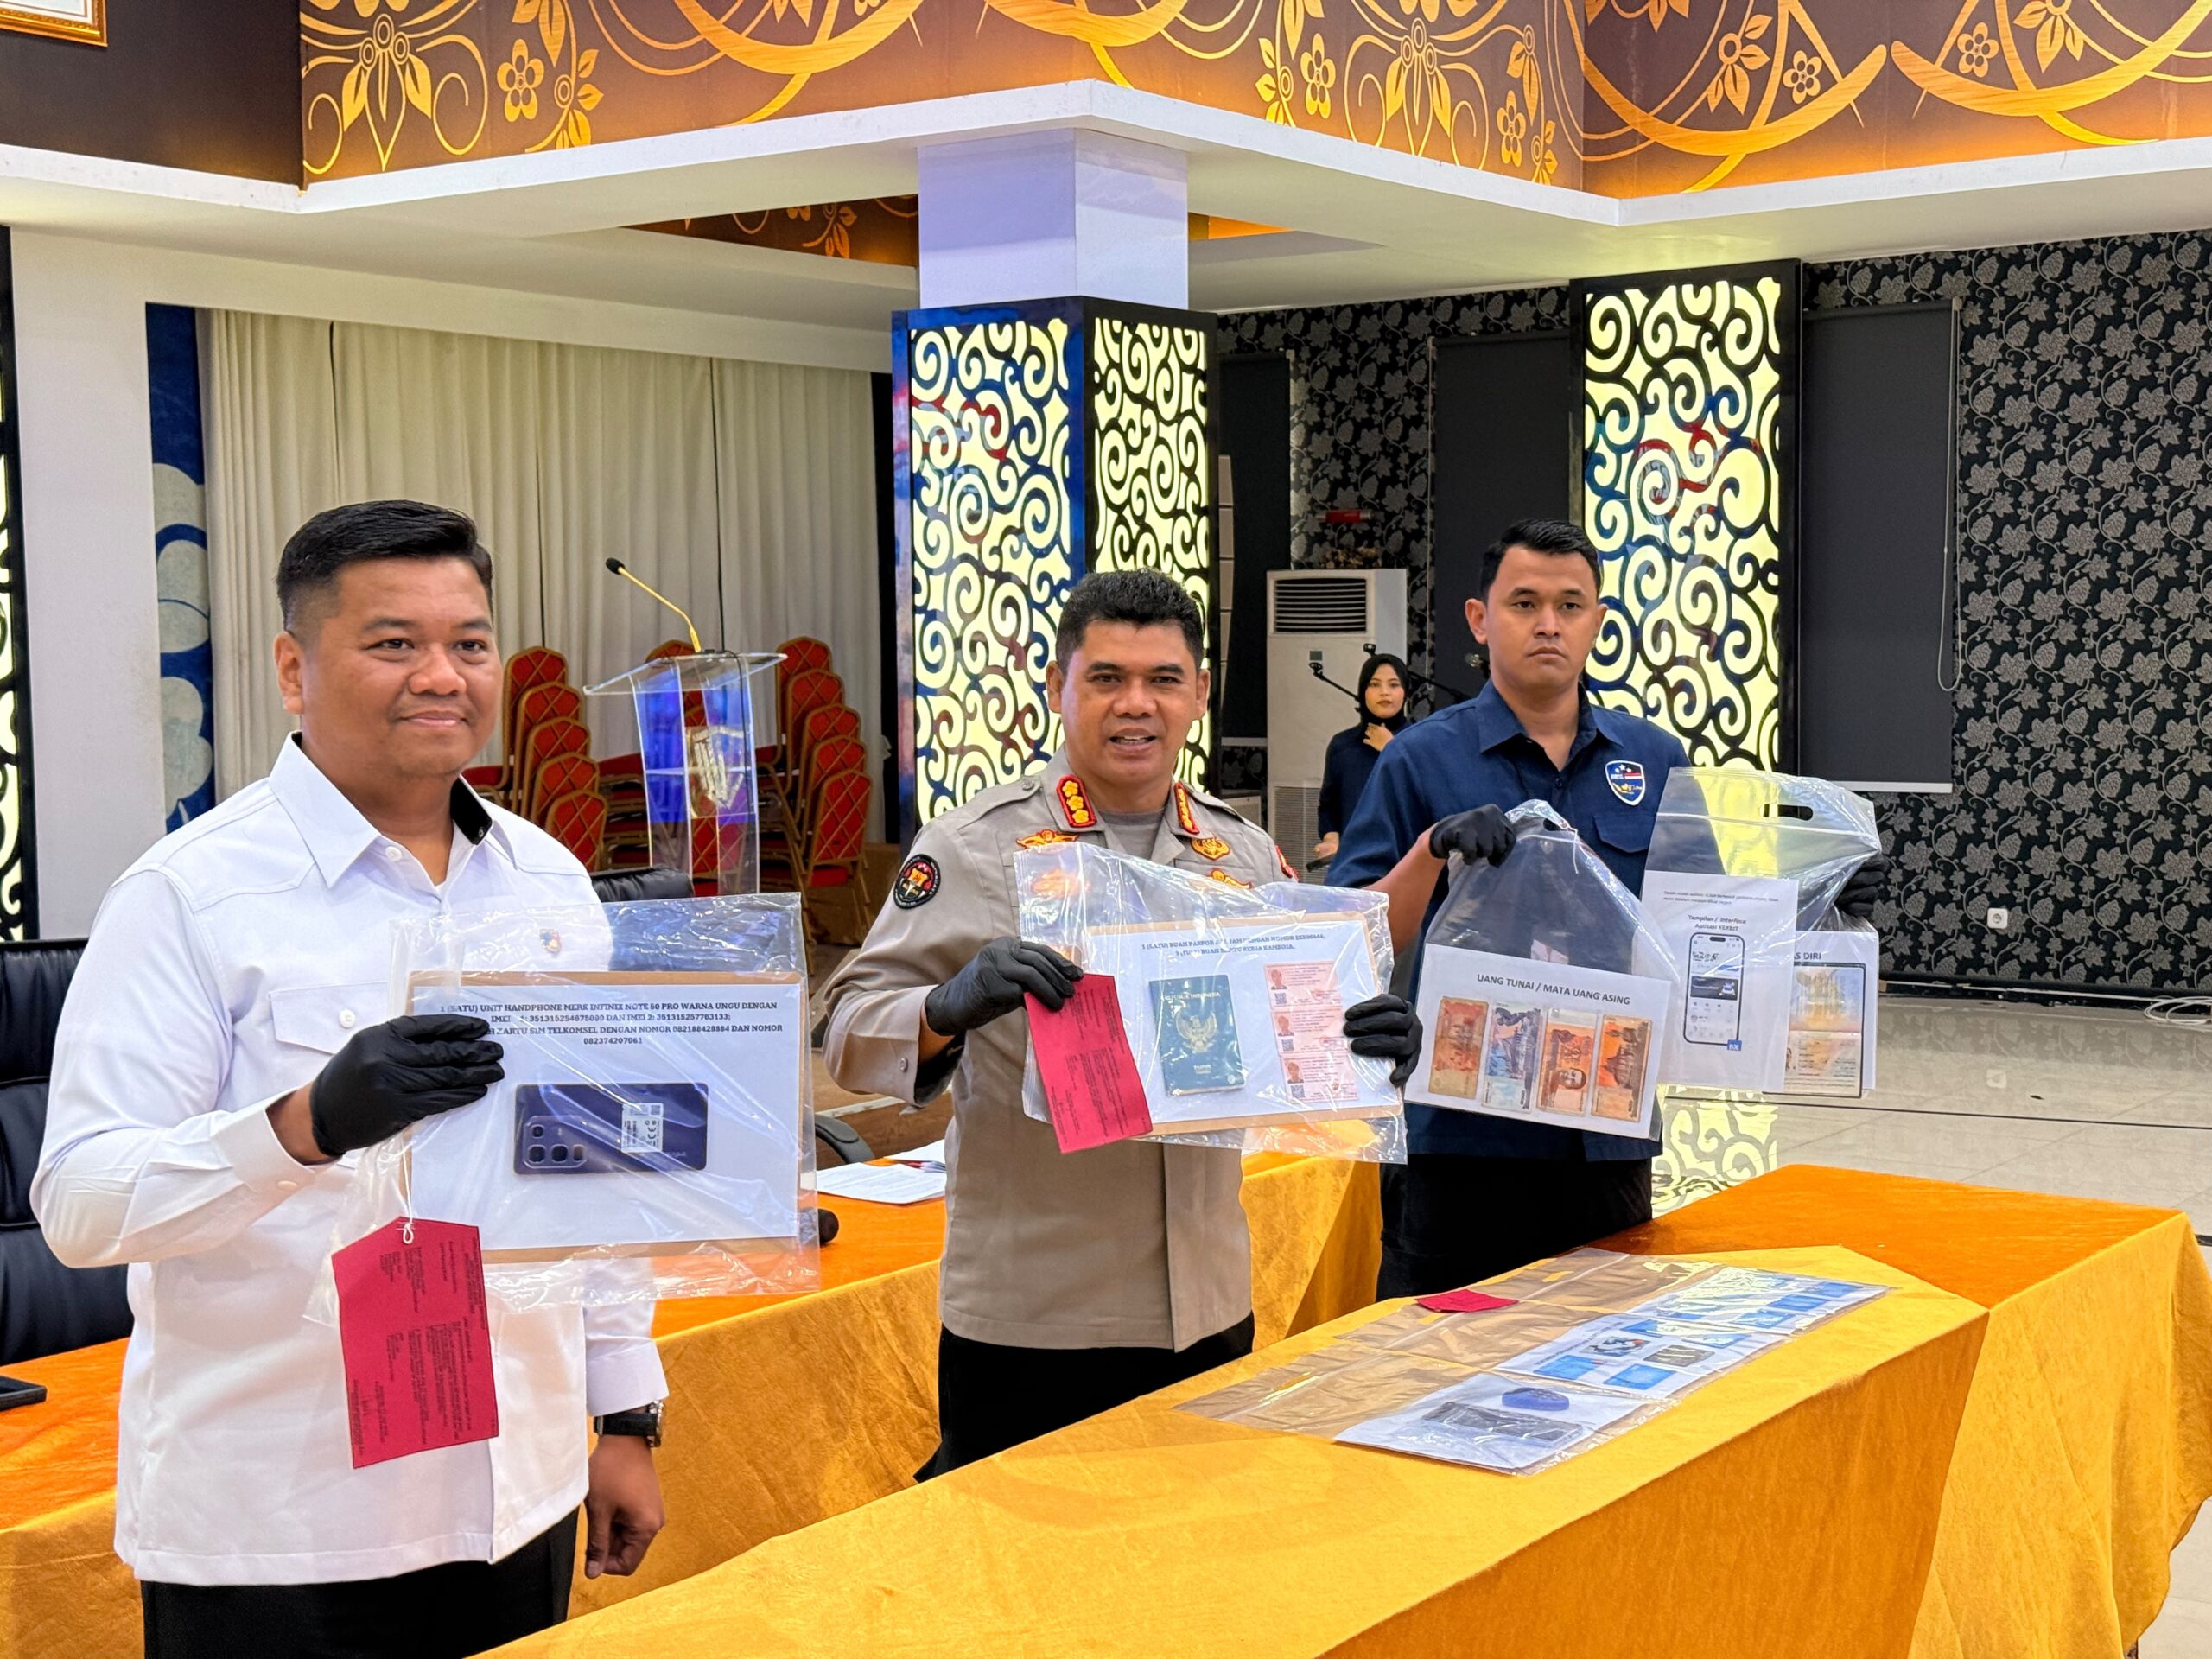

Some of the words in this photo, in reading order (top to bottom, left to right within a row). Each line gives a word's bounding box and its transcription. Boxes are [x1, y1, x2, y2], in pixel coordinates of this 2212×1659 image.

[1477, 973, 1504, 986] UANG
[1506, 978, 1535, 990] TUNAI
[1535, 982, 1541, 992] /
[1543, 984, 1571, 996] MATA
[1573, 989, 1600, 1001] UANG
[1602, 993, 1631, 1005] ASING
[480, 1004, 503, 1013] UNIT
[548, 1026, 598, 1034] TELKOMSEL
[600, 1025, 637, 1034] DENGAN
[639, 1025, 671, 1033] NOMOR
[731, 1024, 750, 1033] DAN
[751, 1024, 783, 1033] NOMOR
